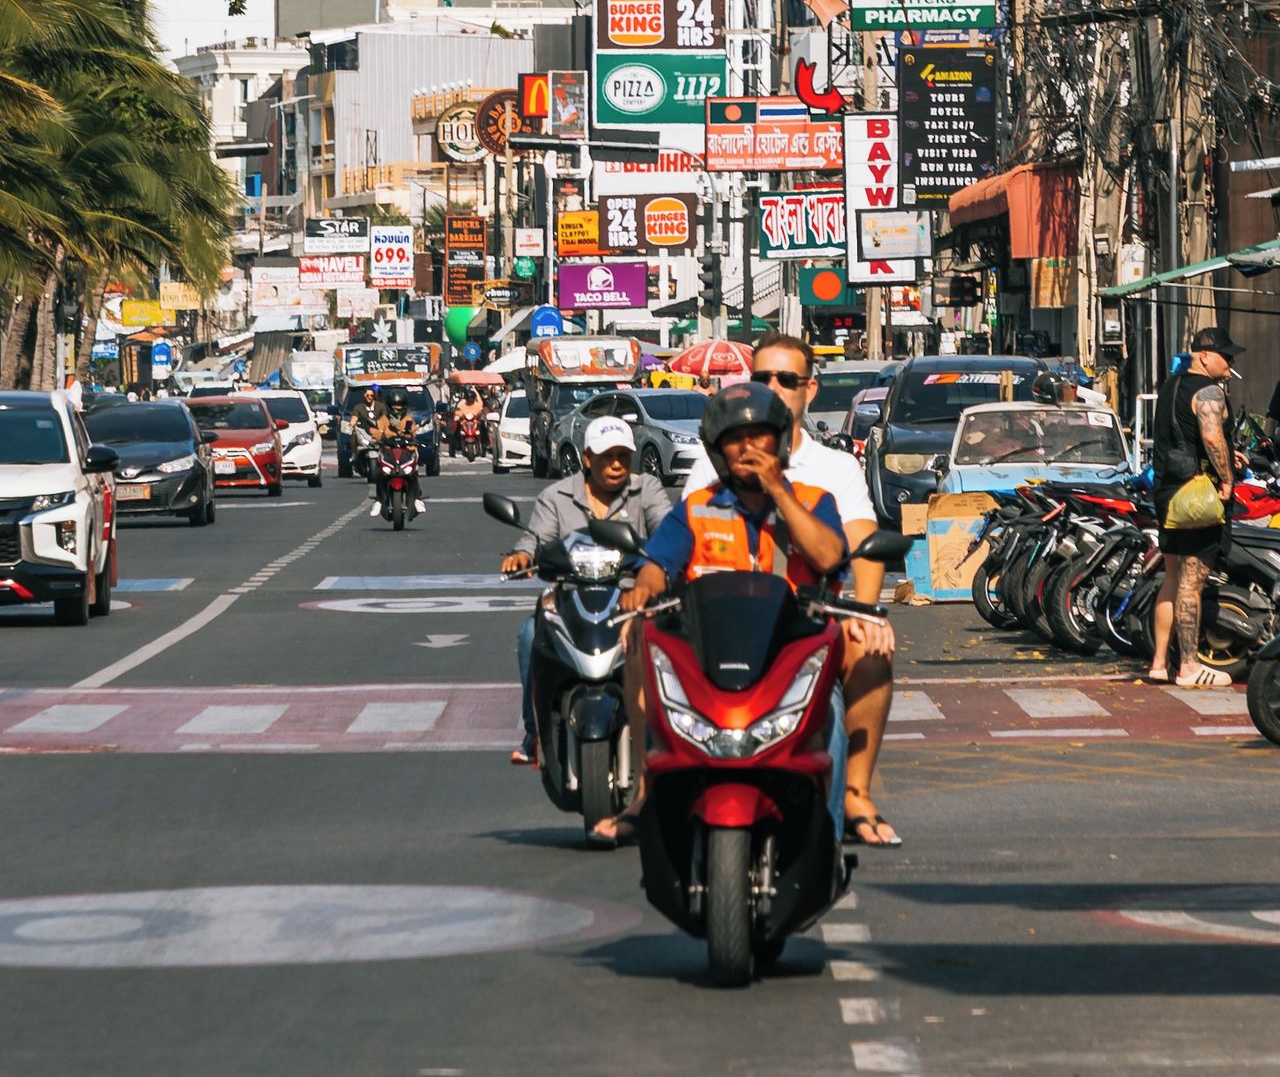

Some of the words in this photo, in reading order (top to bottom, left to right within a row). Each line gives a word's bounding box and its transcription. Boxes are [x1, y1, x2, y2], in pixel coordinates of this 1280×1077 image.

[610, 4, 662, 15] BURGER
[865, 8, 981, 24] PHARMACY
[610, 16, 662, 32] KING
[677, 27, 714, 46] HRS
[935, 72, 972, 81] AMAZON
[613, 80, 655, 97] PIZZA
[673, 76, 721, 101] 1112
[930, 93, 965, 103] TOURS
[930, 107, 965, 116] HOTEL
[924, 121, 949, 130] TAXI
[952, 121, 975, 131] 24/7
[927, 135, 968, 144] TICKET
[917, 149, 948, 158] VISIT
[952, 149, 977, 158] VISA
[921, 163, 944, 172] RUN
[948, 163, 974, 172] VISA
[607, 198, 637, 210] OPEN
[607, 210, 637, 231] 24
[646, 213, 686, 222] BURGER
[316, 220, 360, 235] STAR
[646, 222, 687, 235] KING
[608, 231, 638, 247] HRS
[574, 292, 602, 302] TACO
[602, 292, 630, 302] BELL
